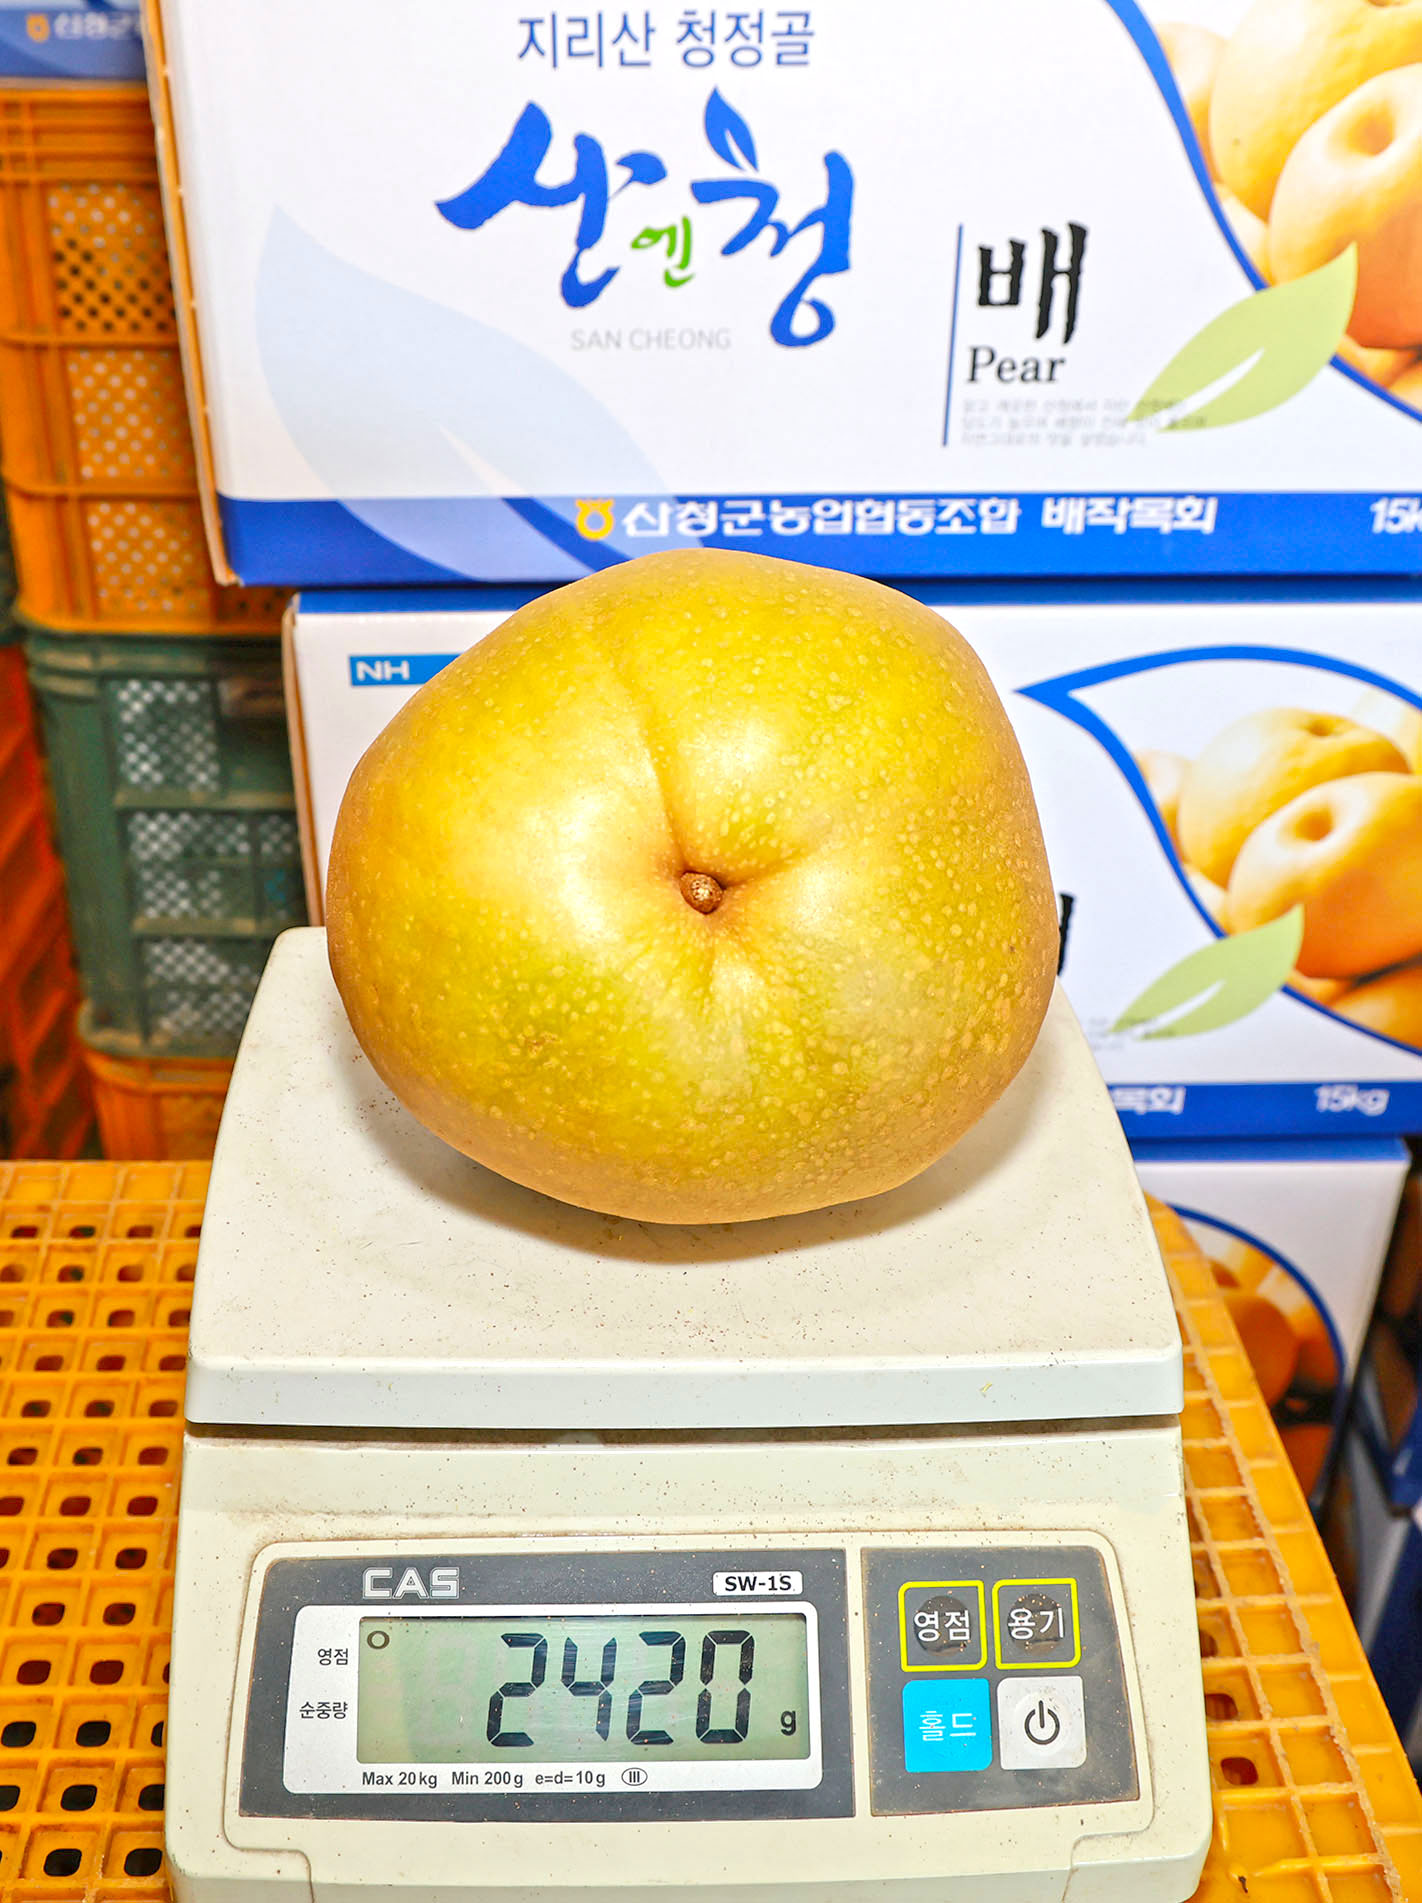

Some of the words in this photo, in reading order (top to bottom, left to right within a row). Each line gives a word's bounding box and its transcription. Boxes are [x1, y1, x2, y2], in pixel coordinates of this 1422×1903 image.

[517, 10, 656, 69] 지리산
[676, 9, 815, 68] 청정골
[977, 221, 1088, 345] 배
[571, 329, 621, 349] SAN
[629, 329, 731, 348] CHEONG
[967, 345, 1067, 384] Pear
[355, 660, 411, 682] NH
[362, 1567, 460, 1600] CAS
[724, 1575, 792, 1592] SW-1S
[913, 1608, 971, 1643] 영점
[1007, 1606, 1064, 1640] 용기
[317, 1647, 349, 1667] 영점
[486, 1630, 756, 1748] 2420
[780, 1710, 796, 1736] g
[299, 1700, 349, 1720] 순중량
[919, 1710, 976, 1742] 홀드
[361, 1771, 394, 1786] Max
[451, 1771, 479, 1786] Min
